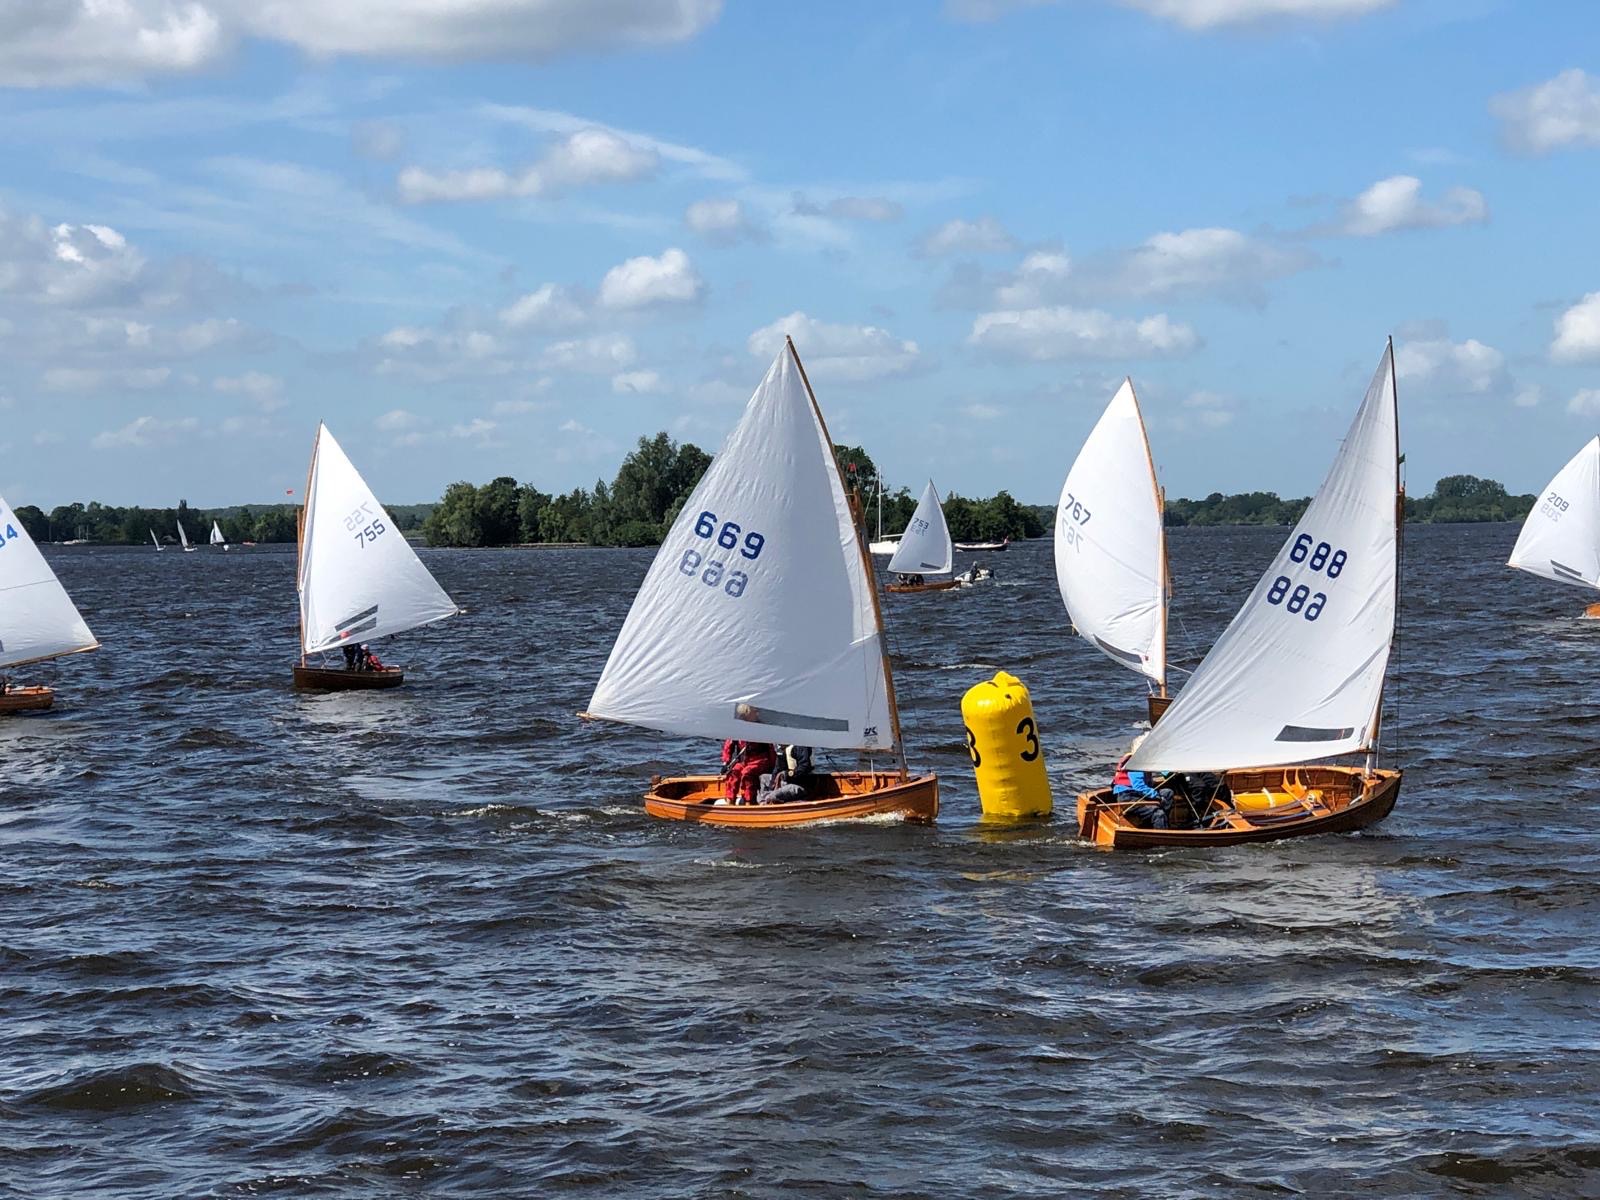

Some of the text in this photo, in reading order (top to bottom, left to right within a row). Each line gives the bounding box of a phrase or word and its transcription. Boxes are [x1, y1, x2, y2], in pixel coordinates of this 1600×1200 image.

[912, 517, 929, 530] 753
[1065, 493, 1091, 525] 767
[354, 518, 385, 549] 755
[694, 510, 765, 560] 669
[1289, 533, 1348, 579] 688
[1016, 717, 1039, 762] 3
